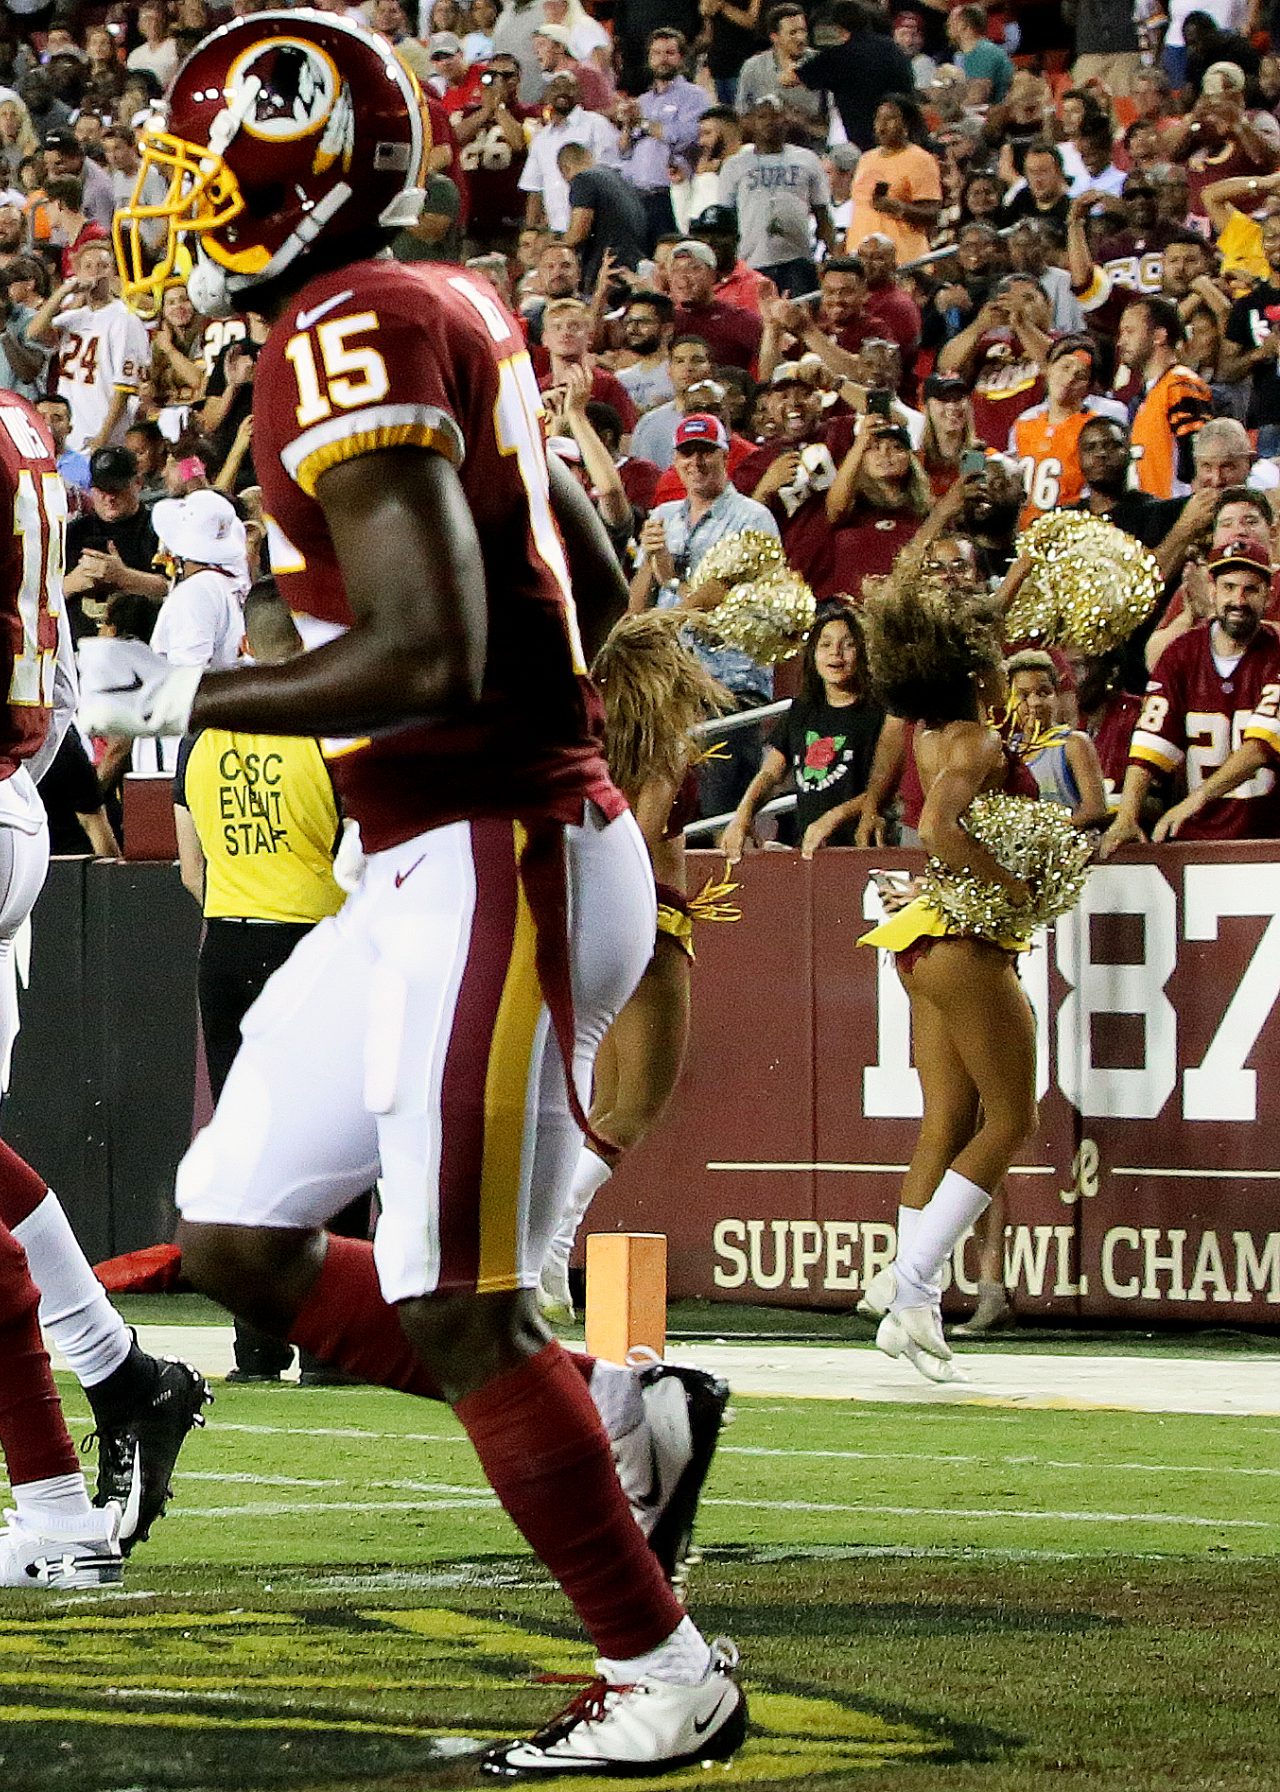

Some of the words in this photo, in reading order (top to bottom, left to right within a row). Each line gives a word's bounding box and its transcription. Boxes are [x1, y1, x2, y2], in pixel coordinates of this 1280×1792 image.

[59, 332, 99, 385] 24
[284, 309, 391, 428] 15
[219, 748, 283, 785] CSC
[219, 786, 282, 825] EVENT
[863, 864, 1280, 1122] 187
[713, 1217, 898, 1291] SUPER
